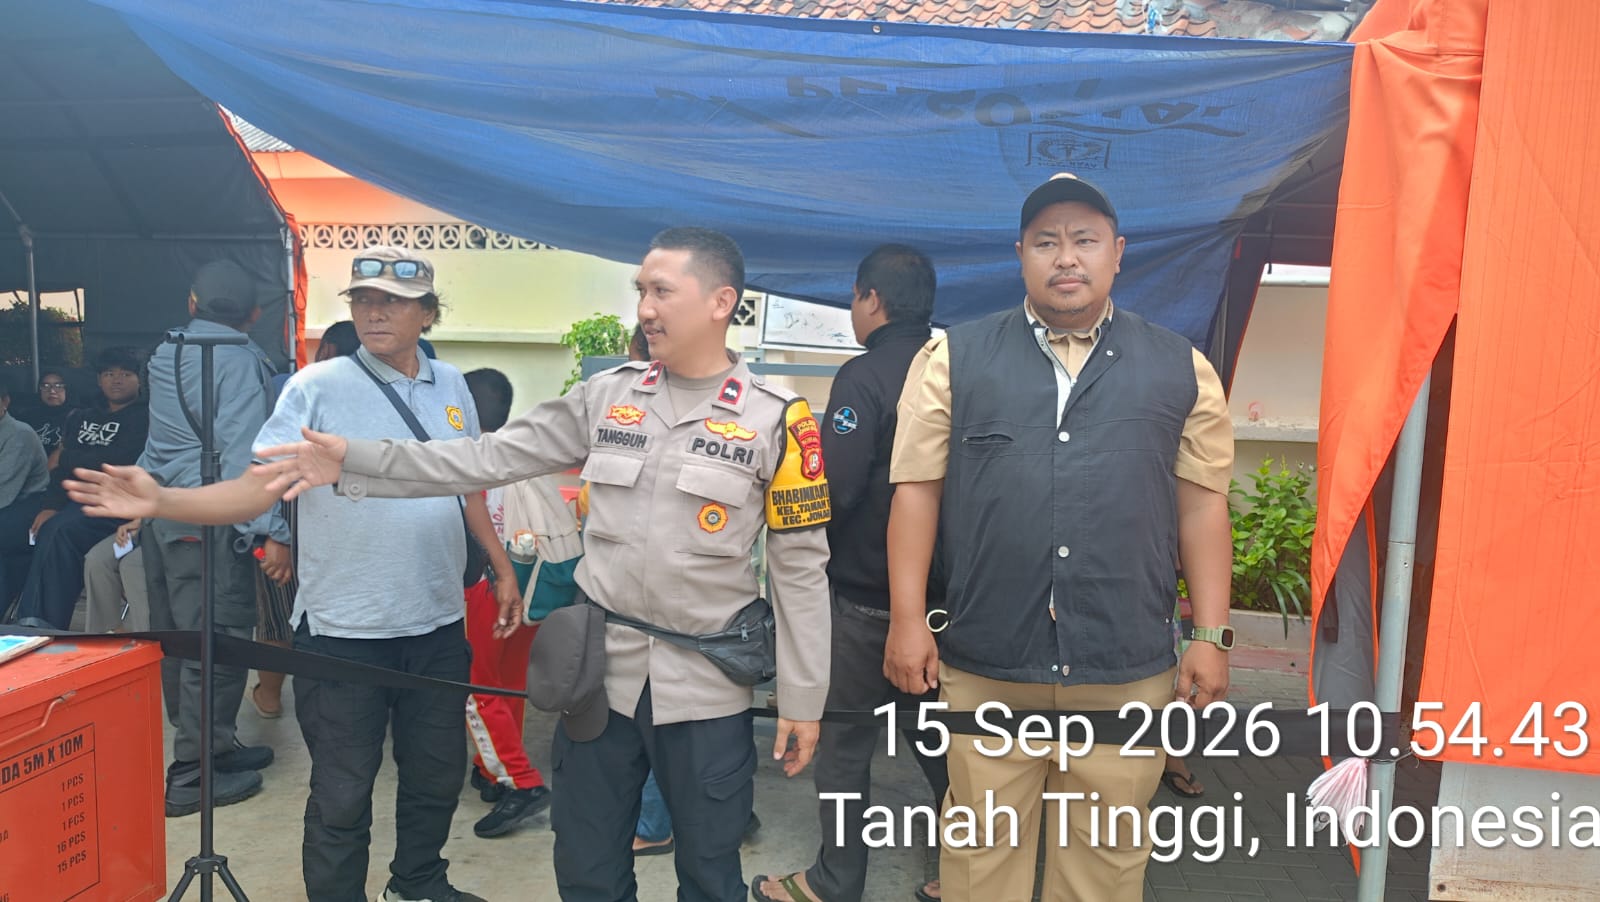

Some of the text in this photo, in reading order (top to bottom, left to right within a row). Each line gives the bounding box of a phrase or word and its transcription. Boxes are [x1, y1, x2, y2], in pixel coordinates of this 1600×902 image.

[597, 428, 648, 449] TANGGUH
[691, 437, 754, 465] POLRI
[23, 751, 44, 775] 5M
[47, 746, 55, 765] X
[59, 734, 83, 758] 10M
[67, 773, 84, 790] PCS
[68, 793, 85, 809] PCS
[68, 831, 86, 848] PCS
[69, 850, 87, 867] PCS
